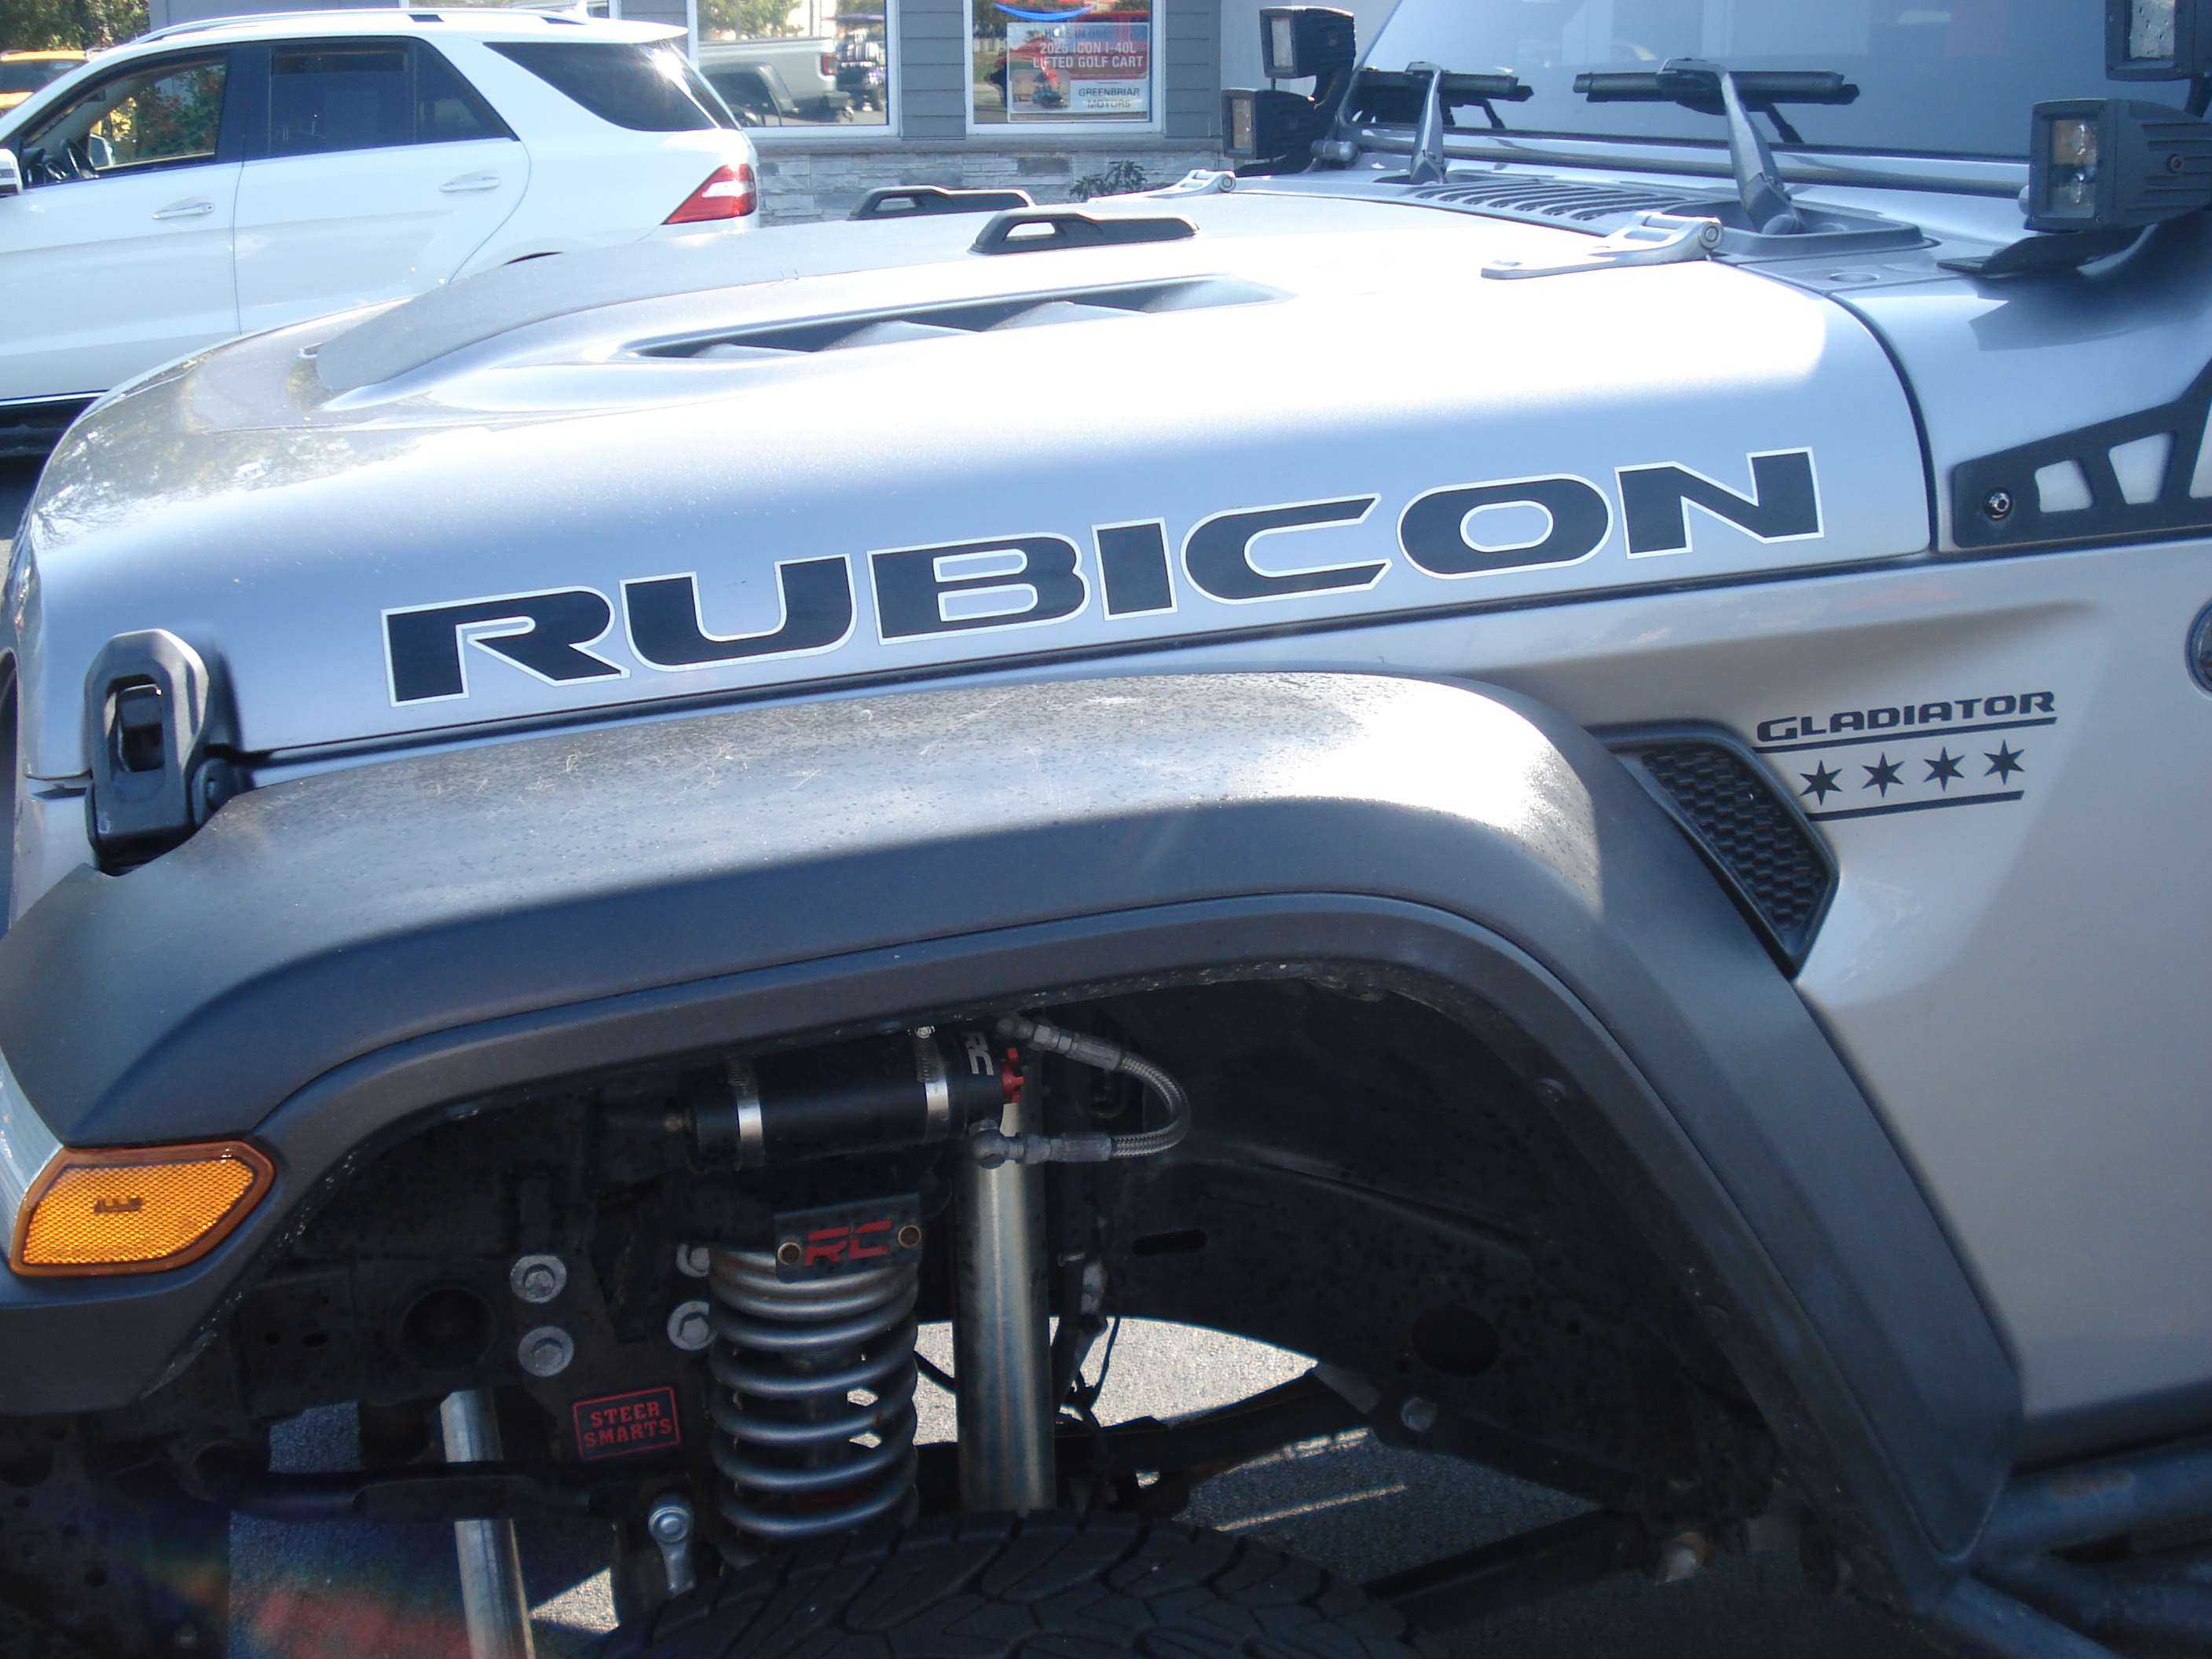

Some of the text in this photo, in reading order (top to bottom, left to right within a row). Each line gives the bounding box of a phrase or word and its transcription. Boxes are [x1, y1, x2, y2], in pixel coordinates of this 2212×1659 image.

[1073, 42, 1101, 53] ICON
[1033, 56, 1144, 68] LIFTED GOLF CART
[1079, 87, 1140, 97] GREENBRIAR
[1087, 99, 1131, 108] MOTORS
[381, 447, 1826, 706] RUBICON
[1757, 691, 2055, 742] GLADIATOR
[804, 1219, 894, 1266] RC
[590, 1401, 660, 1428] STEER
[584, 1418, 673, 1448] SMARTS
